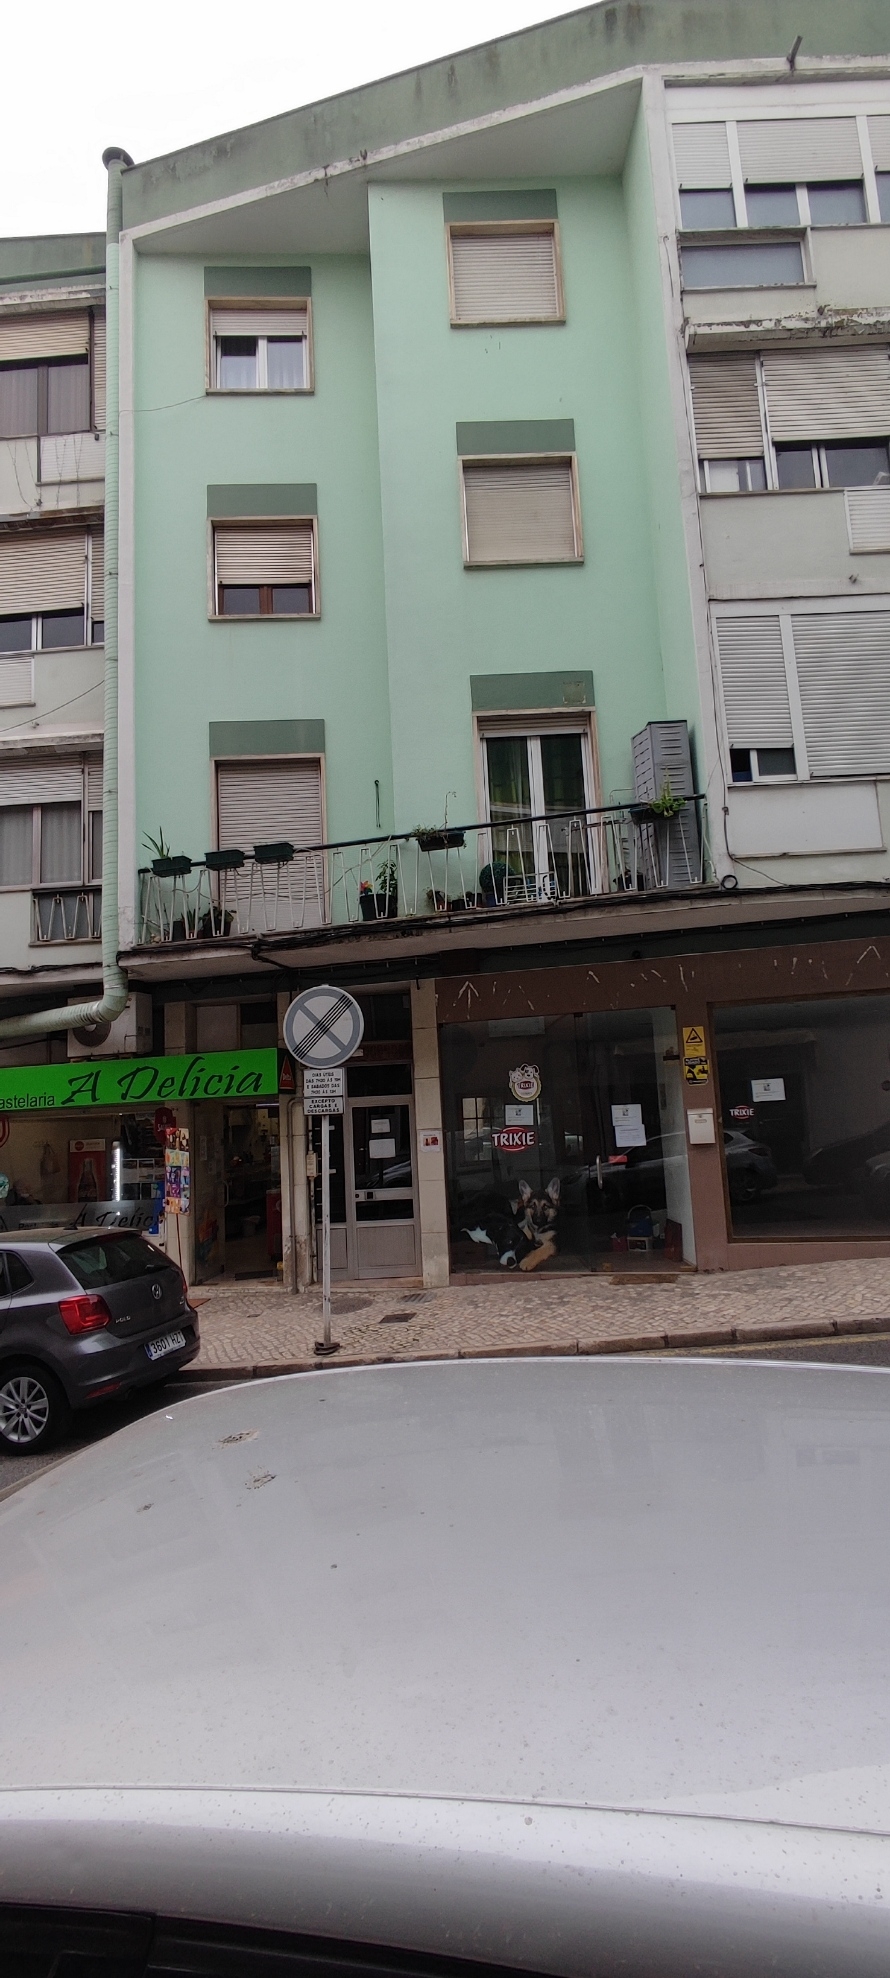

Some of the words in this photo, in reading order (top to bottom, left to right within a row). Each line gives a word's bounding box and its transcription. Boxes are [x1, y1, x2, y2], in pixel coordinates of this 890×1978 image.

[61, 1069, 102, 1105] A
[516, 1080, 535, 1090] TRIXIE
[729, 1107, 755, 1117] TRIXIE
[491, 1131, 535, 1147] TRIXIE
[151, 1336, 171, 1354] 3601
